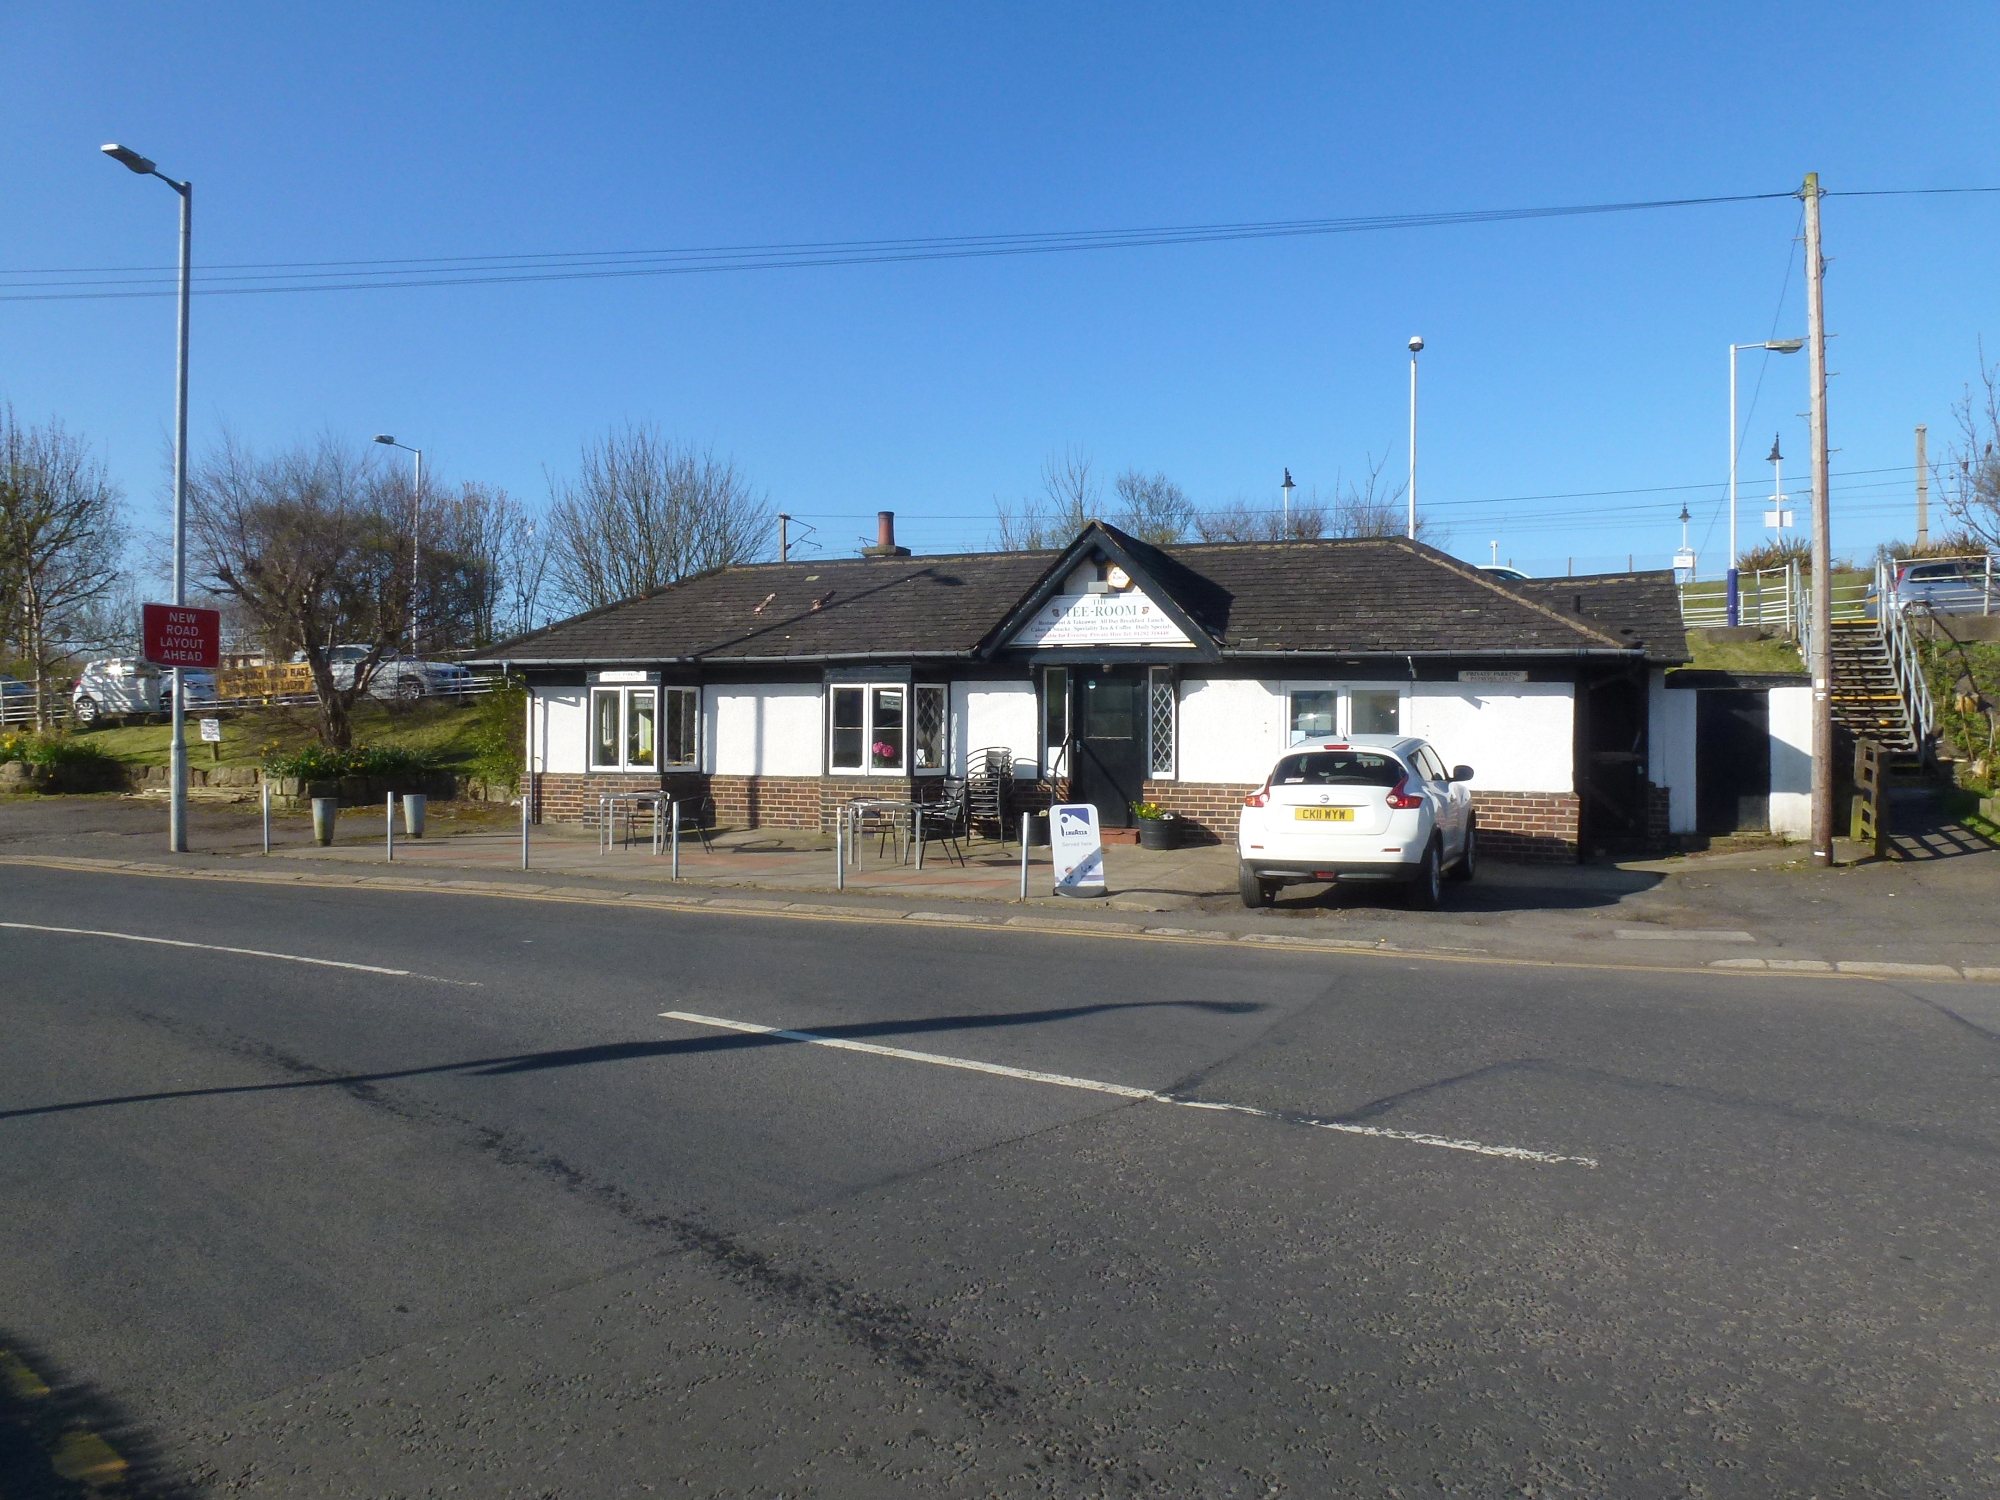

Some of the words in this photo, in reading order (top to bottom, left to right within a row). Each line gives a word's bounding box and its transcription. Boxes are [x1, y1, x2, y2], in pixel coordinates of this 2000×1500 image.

[1064, 606, 1137, 617] TEE-ROOM
[169, 612, 196, 624] NEW
[167, 625, 198, 637] ROAD
[160, 637, 204, 649] LAYOUT
[163, 650, 203, 662] AHEAD
[1303, 810, 1321, 819] CK11
[1325, 810, 1345, 819] WYW
